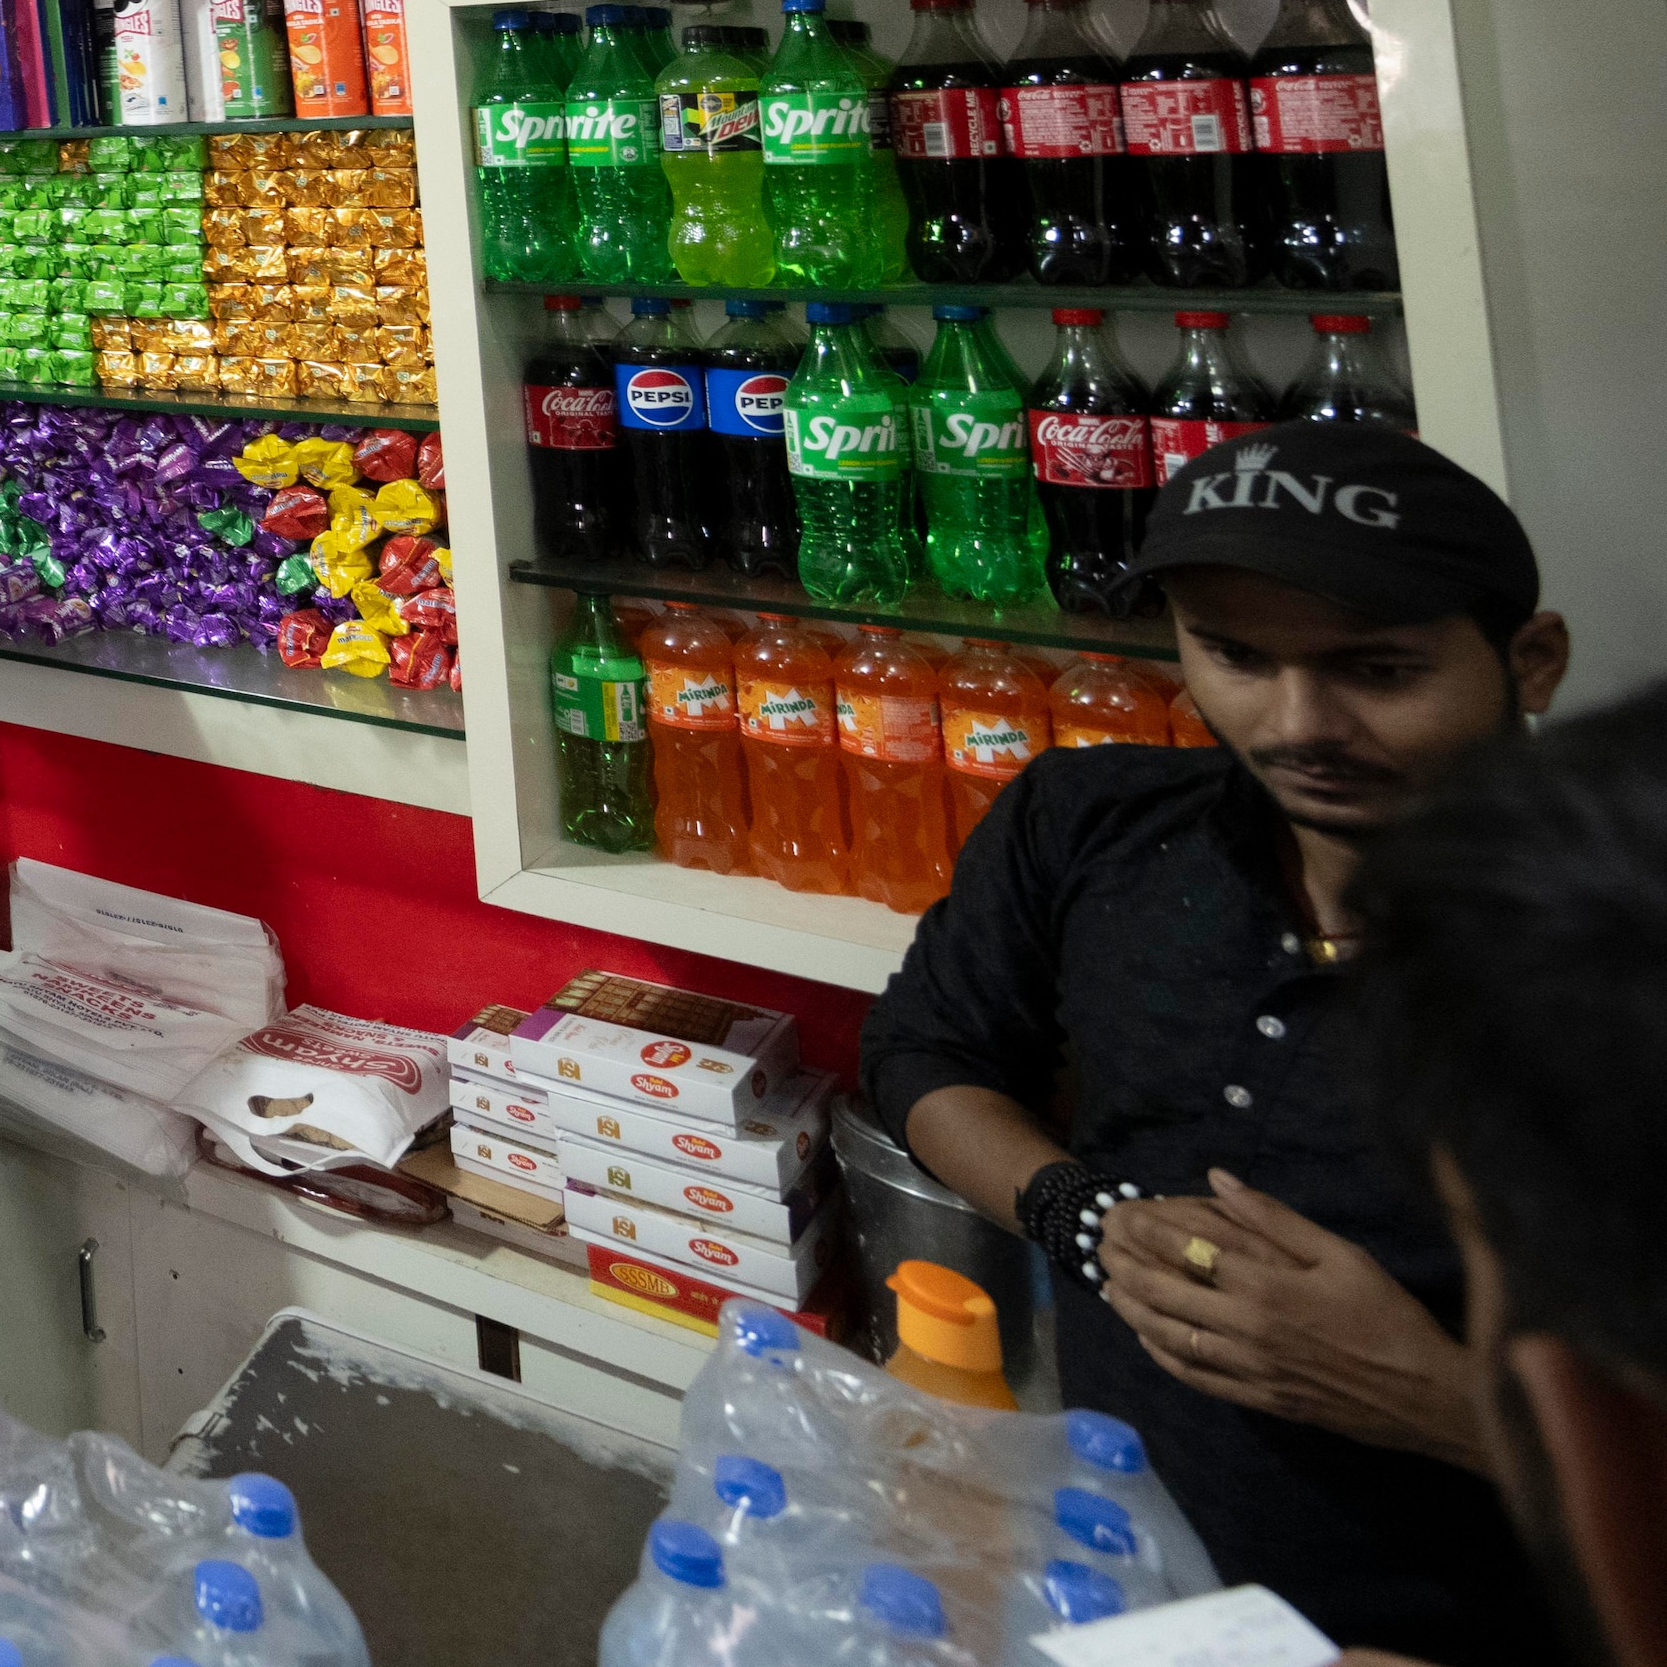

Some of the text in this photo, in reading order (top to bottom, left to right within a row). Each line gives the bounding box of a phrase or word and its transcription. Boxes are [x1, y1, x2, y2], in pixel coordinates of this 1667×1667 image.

[631, 390, 691, 404] PEPSI
[740, 396, 783, 409] PEP
[1036, 414, 1144, 446] Coca-Cola
[1183, 468, 1401, 529] KING
[677, 683, 728, 704] MIRINDA
[760, 698, 816, 717] MIRINDA
[965, 730, 1029, 748] MIRINDA
[42, 982, 133, 1021] SNACKS
[54, 975, 146, 1009] SWEETS
[262, 1033, 396, 1071] Shyam
[634, 1077, 675, 1098] Shyam
[509, 1106, 532, 1121] Shyam
[676, 1136, 717, 1159] Shyam
[511, 1154, 534, 1170] Shyam
[688, 1188, 728, 1210] Shyam
[693, 1241, 734, 1263] Shyam
[617, 1267, 672, 1296] SSSMB
